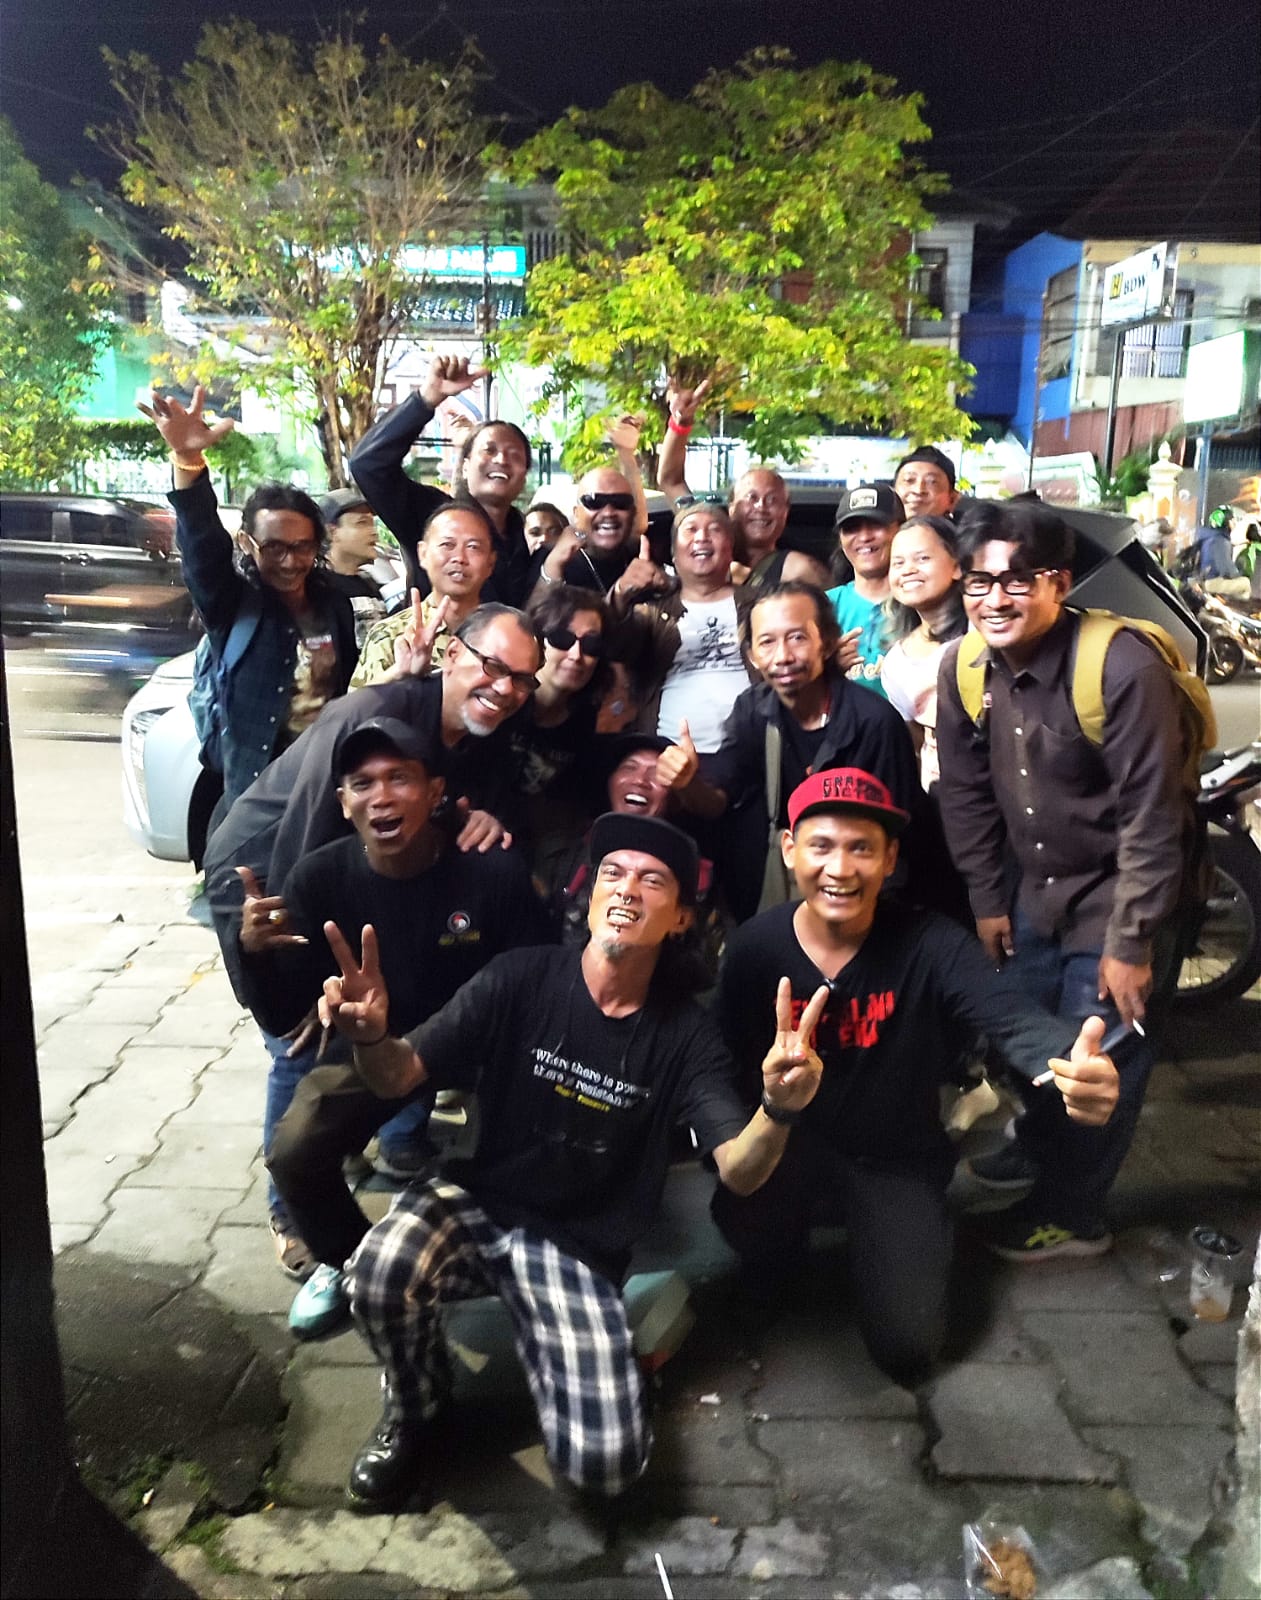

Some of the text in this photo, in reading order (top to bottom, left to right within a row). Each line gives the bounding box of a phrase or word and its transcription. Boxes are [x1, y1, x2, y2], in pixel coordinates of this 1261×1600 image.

[571, 1061, 601, 1083] there
[602, 1074, 614, 1088] is
[575, 1079, 637, 1109] resistan
